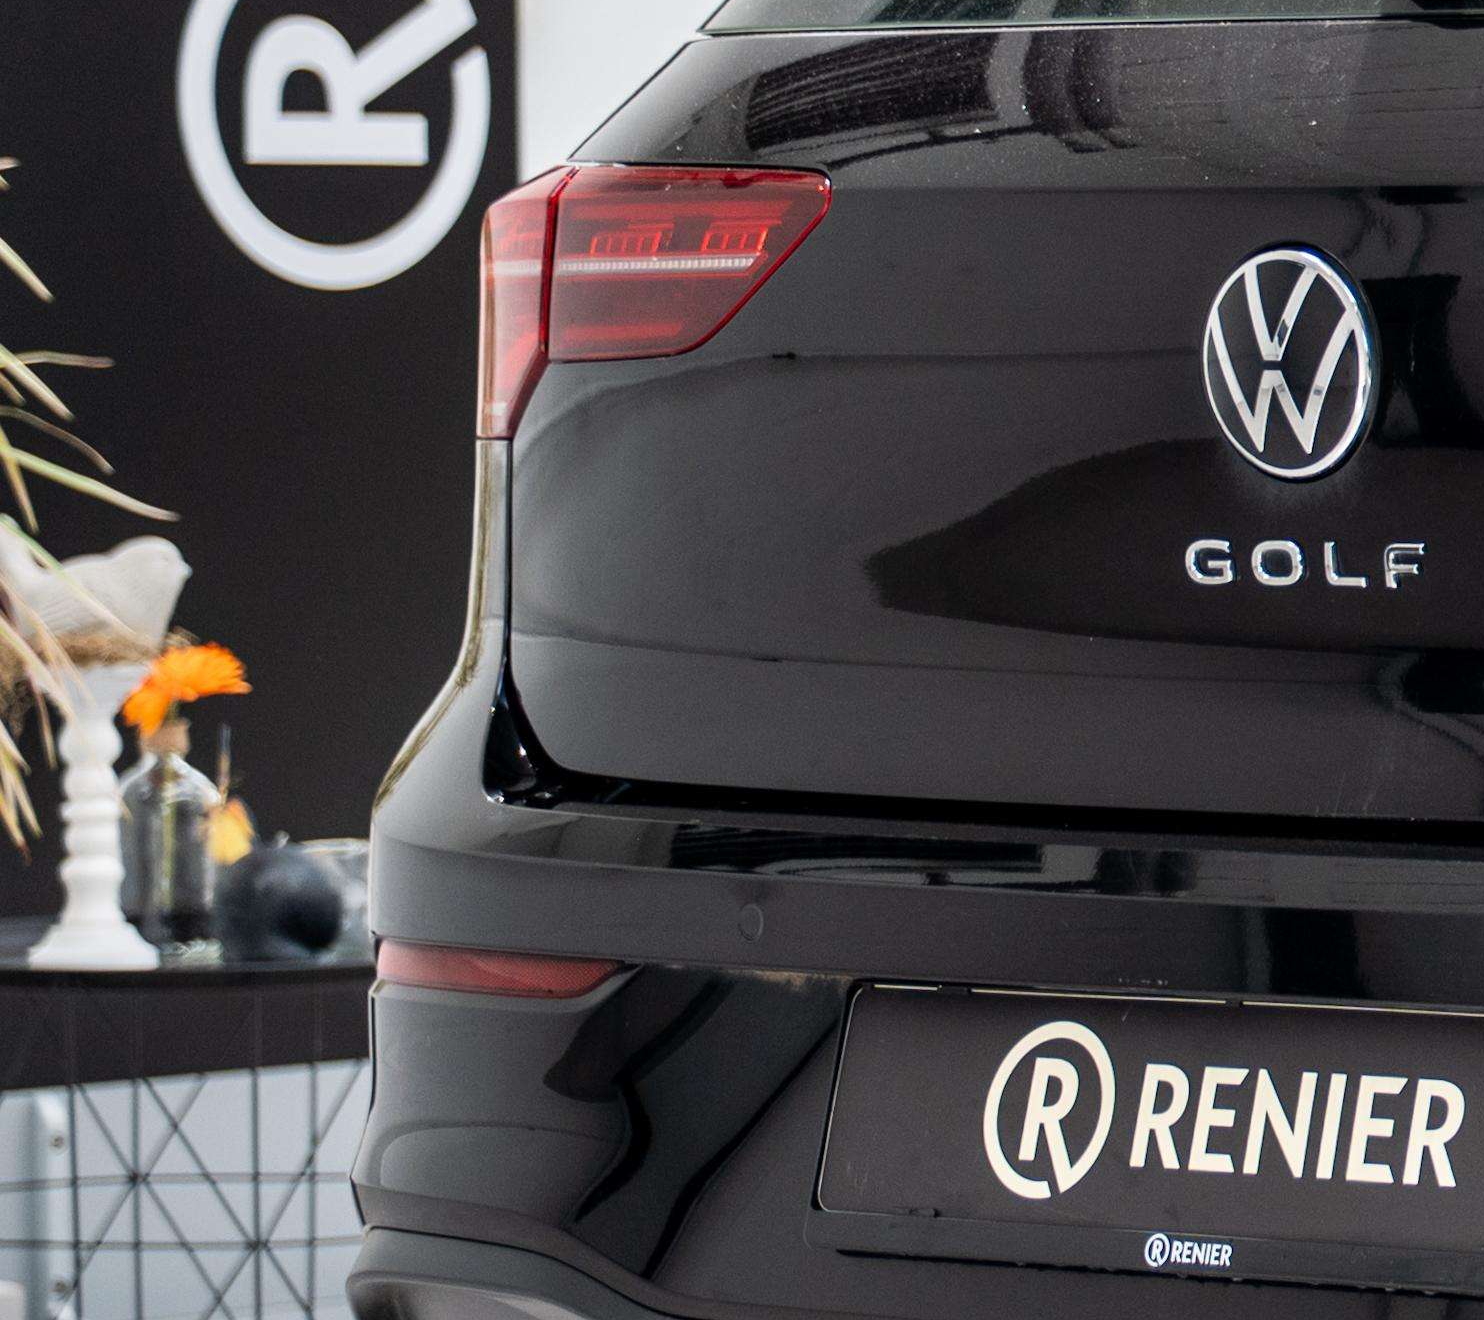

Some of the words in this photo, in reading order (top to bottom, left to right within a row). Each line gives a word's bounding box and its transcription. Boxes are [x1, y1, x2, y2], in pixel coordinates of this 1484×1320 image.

[1184, 538, 1426, 589] GOLF
[1128, 1062, 1466, 1189] RENIER
[1170, 1239, 1233, 1267] RENIER
